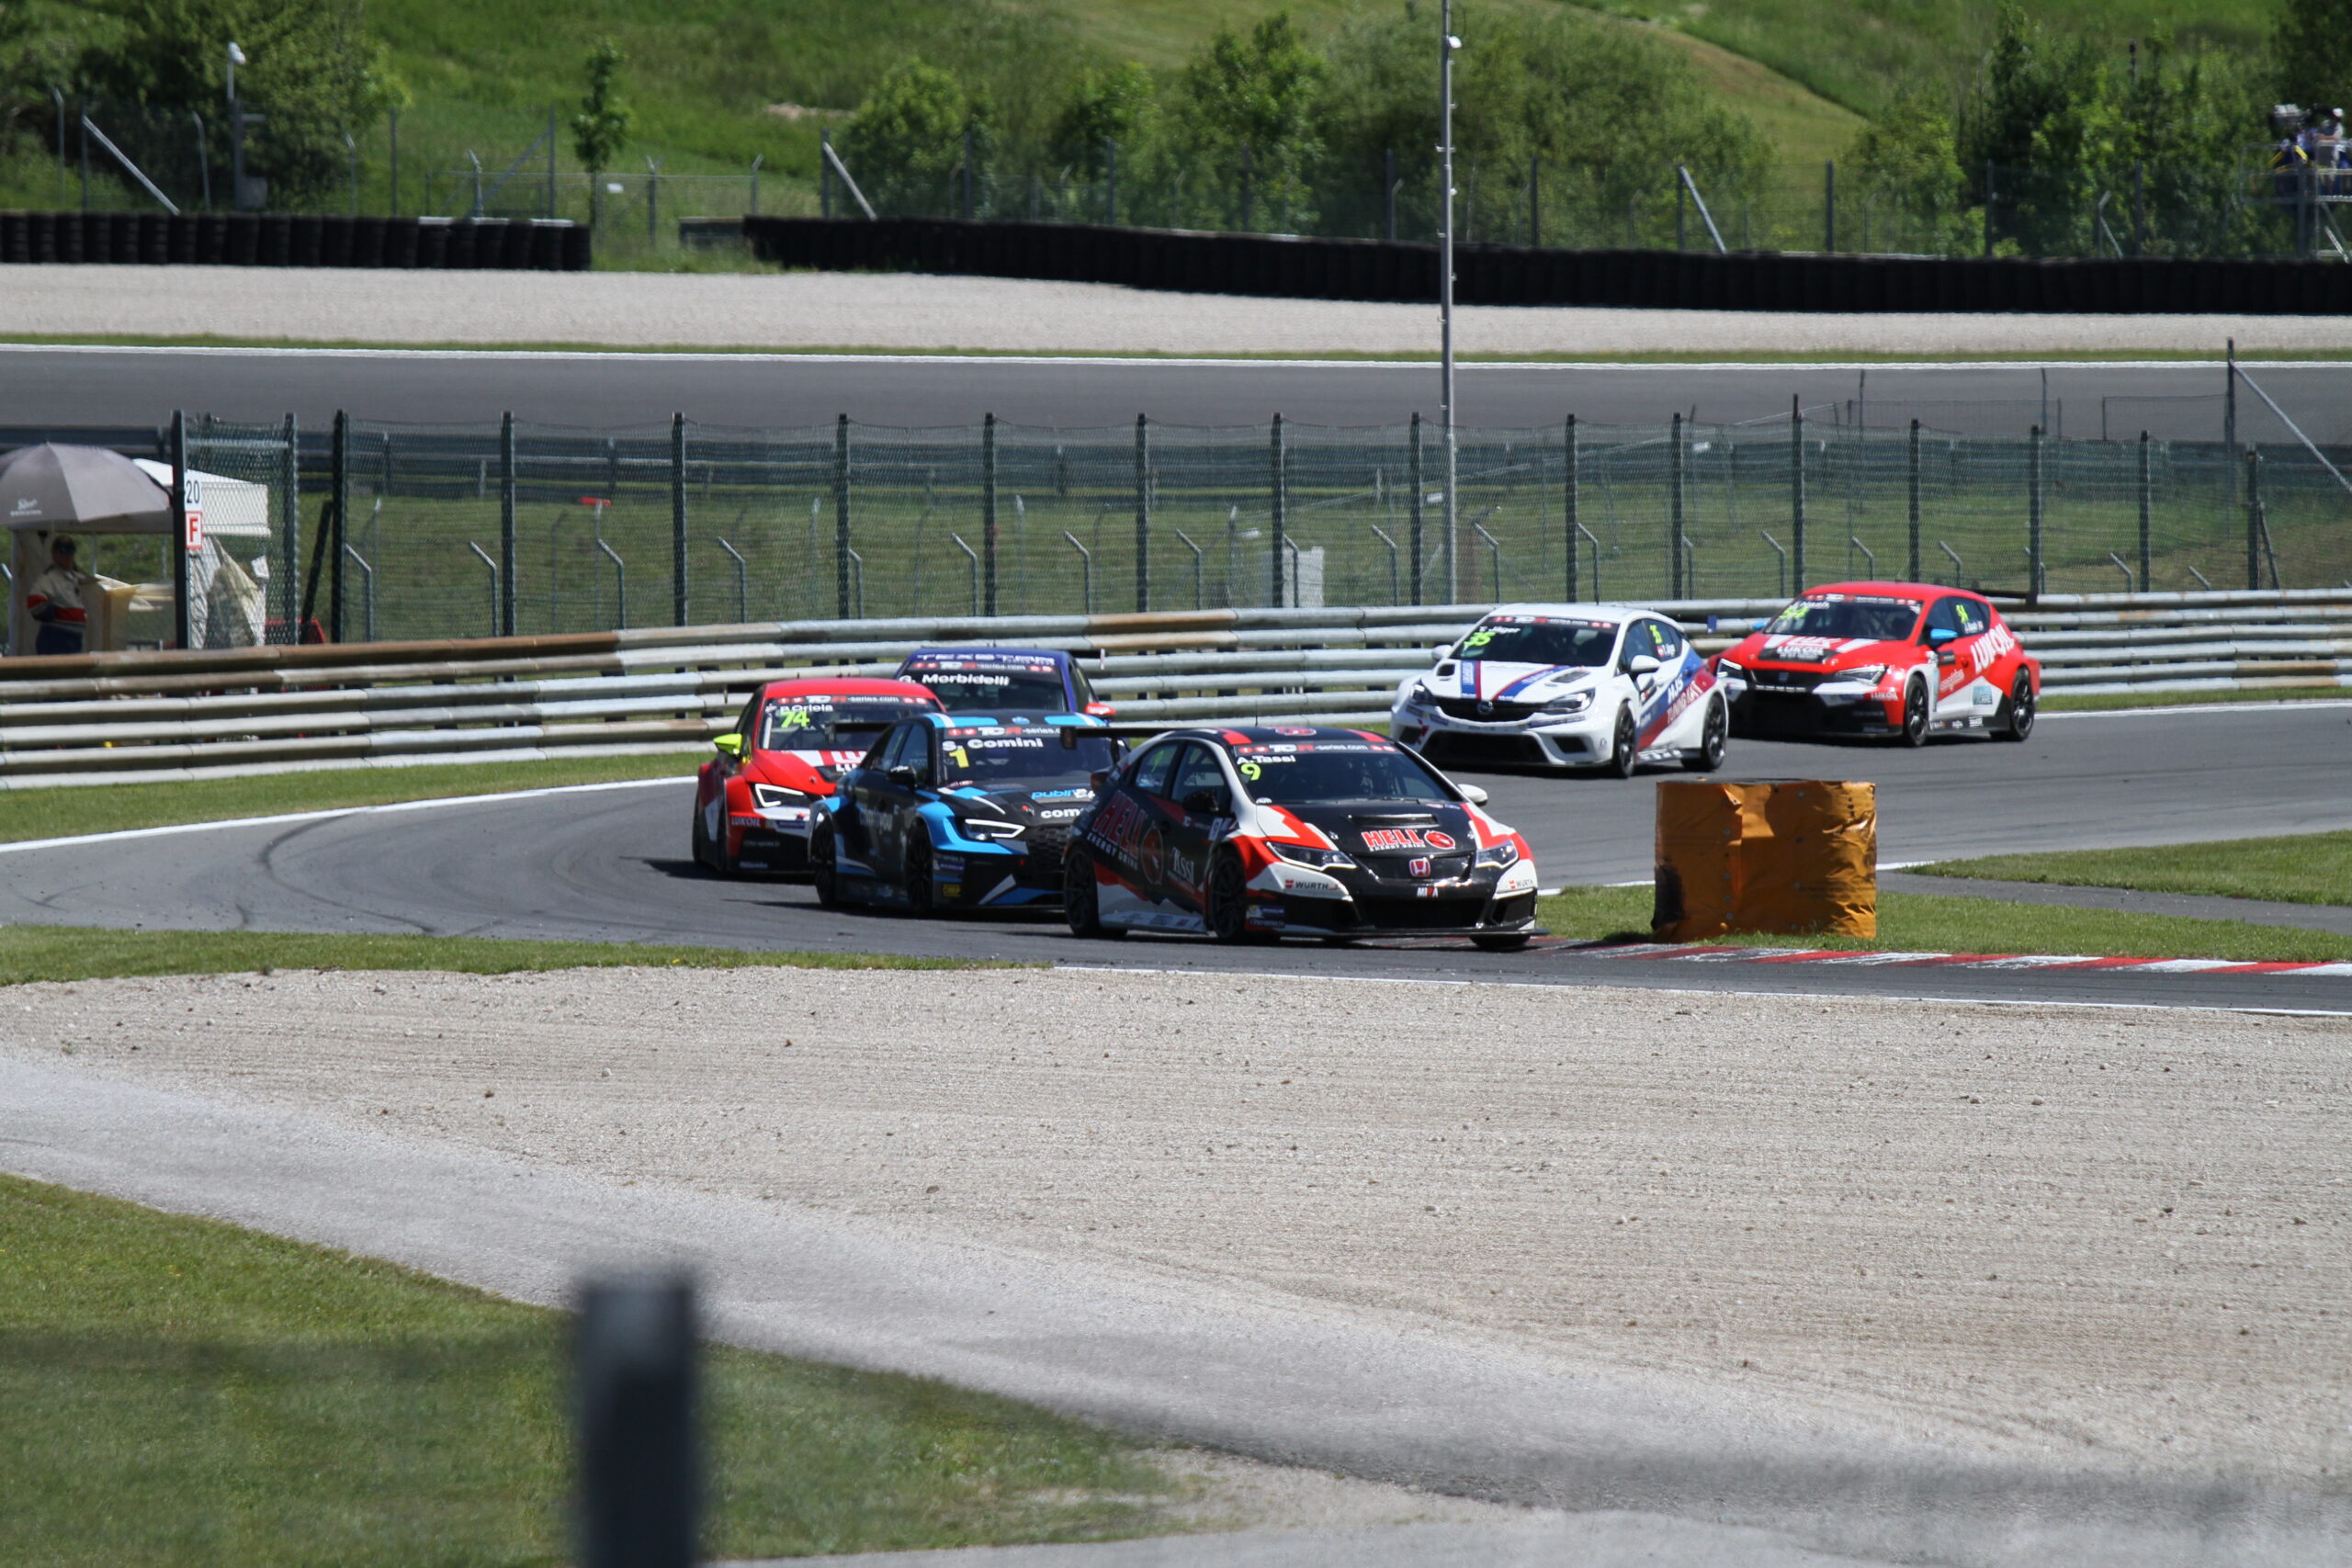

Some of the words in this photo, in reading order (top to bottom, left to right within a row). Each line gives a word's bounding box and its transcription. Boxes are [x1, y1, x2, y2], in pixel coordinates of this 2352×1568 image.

[186, 479, 200, 503] 20
[189, 517, 198, 543] F
[1970, 623, 2015, 675] LUKOIL
[922, 672, 1011, 686] Morbidelli
[781, 711, 810, 728] 74
[943, 740, 963, 751] S.
[967, 738, 1044, 749] Comini
[949, 748, 970, 768] 1
[1240, 762, 1261, 781] 9
[731, 816, 761, 827] LUKOIL
[1091, 789, 1148, 859] HELL
[1086, 831, 1117, 857] ENERGY
[1361, 829, 1425, 848] HELL
